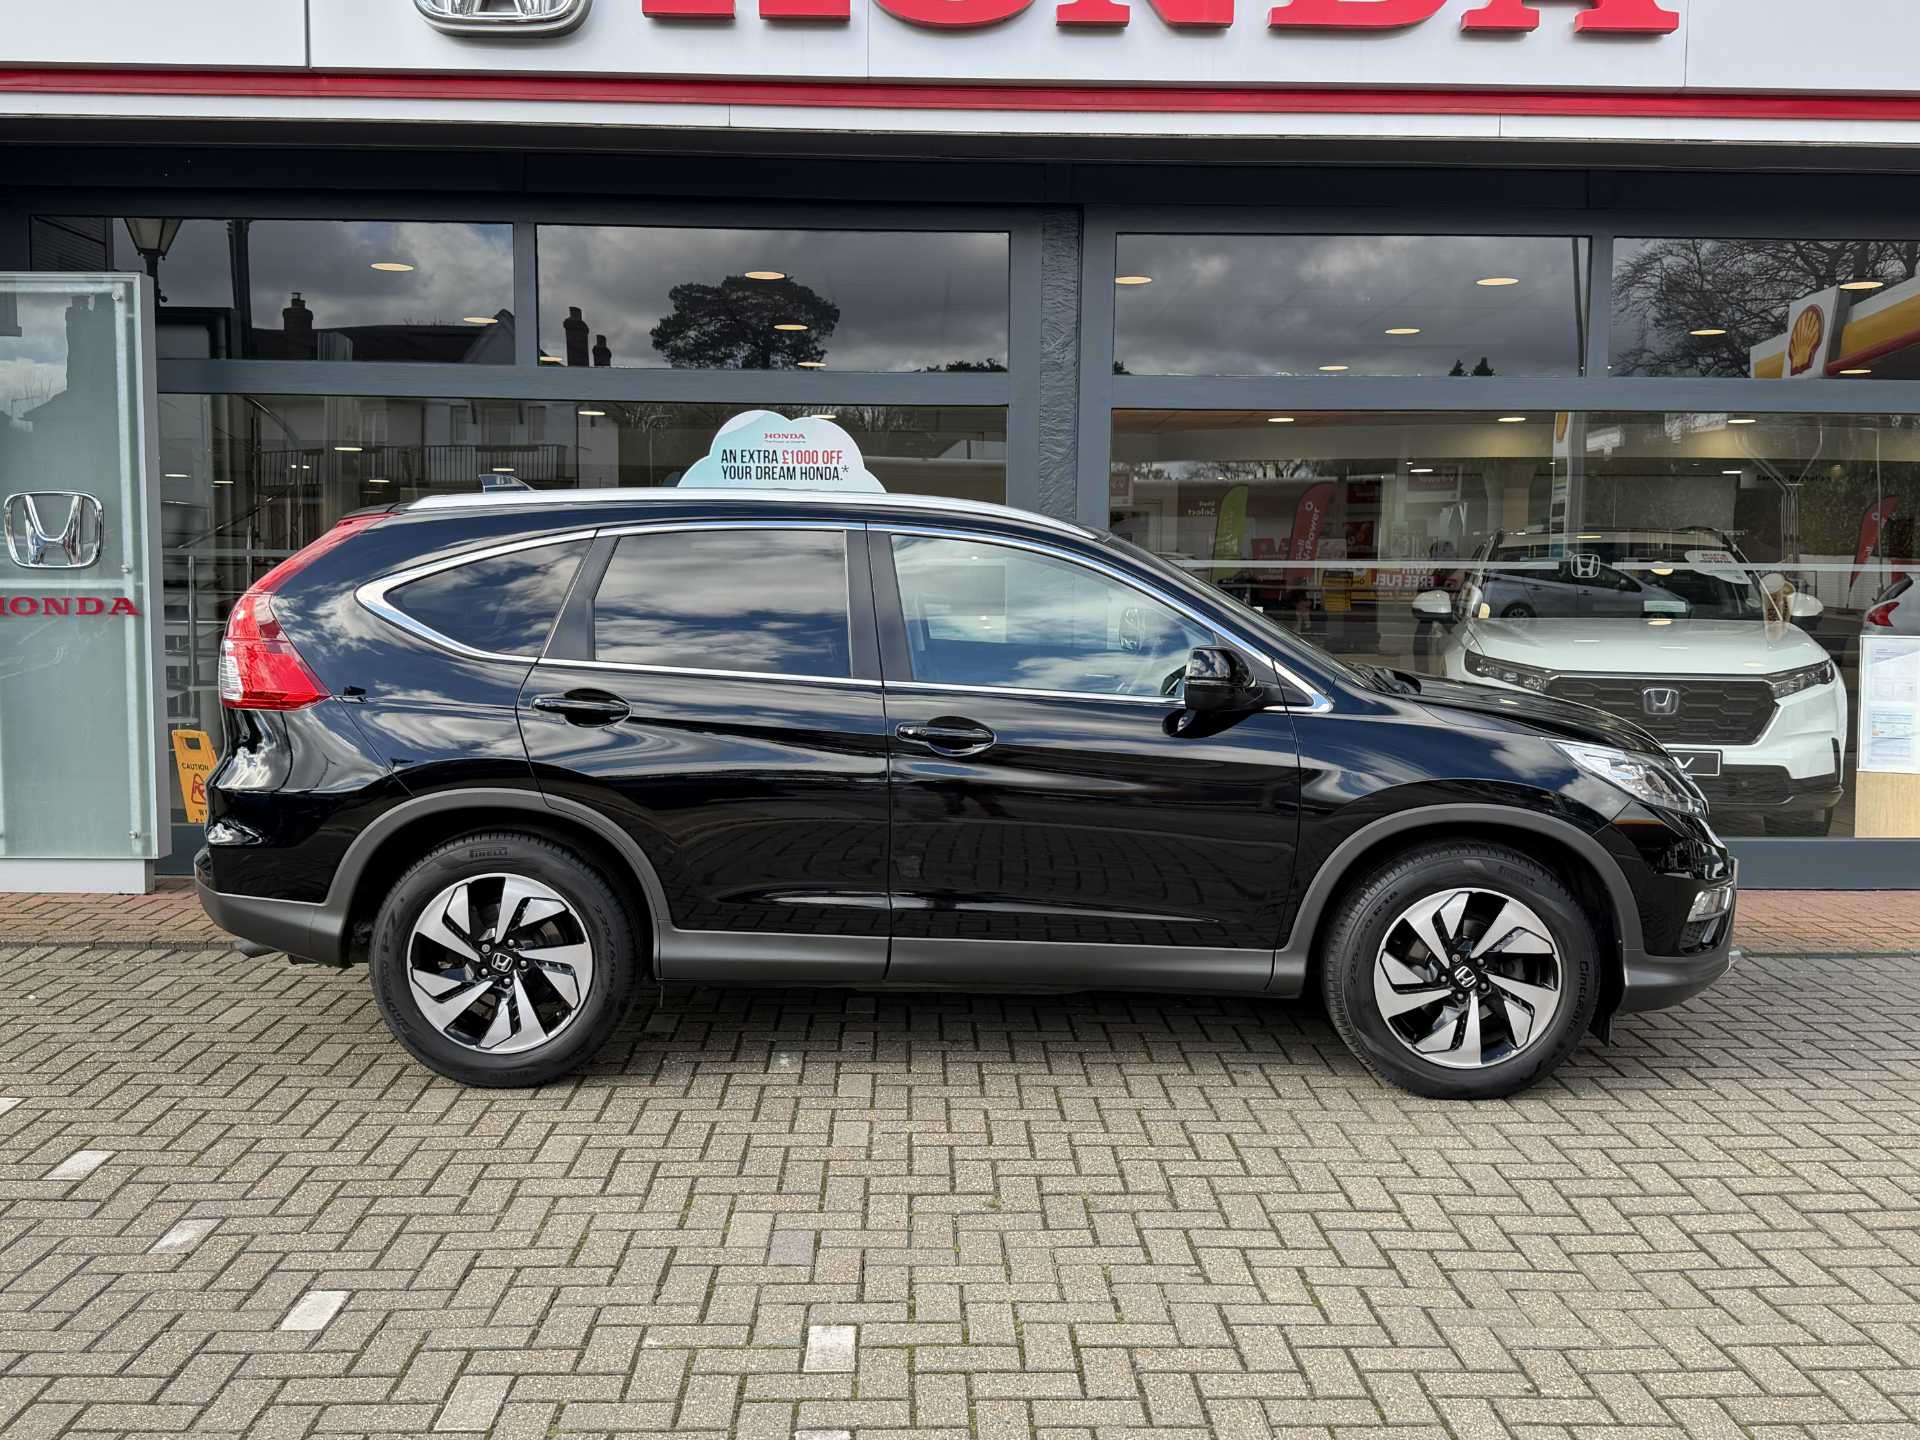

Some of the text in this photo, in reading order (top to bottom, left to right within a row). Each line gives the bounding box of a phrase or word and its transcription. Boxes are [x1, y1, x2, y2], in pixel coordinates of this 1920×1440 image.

[721, 449, 843, 464] AN EXTRA £1000 OFF
[721, 465, 752, 480] YOUR
[755, 466, 796, 480] DREAM
[181, 762, 209, 771] CAUTION
